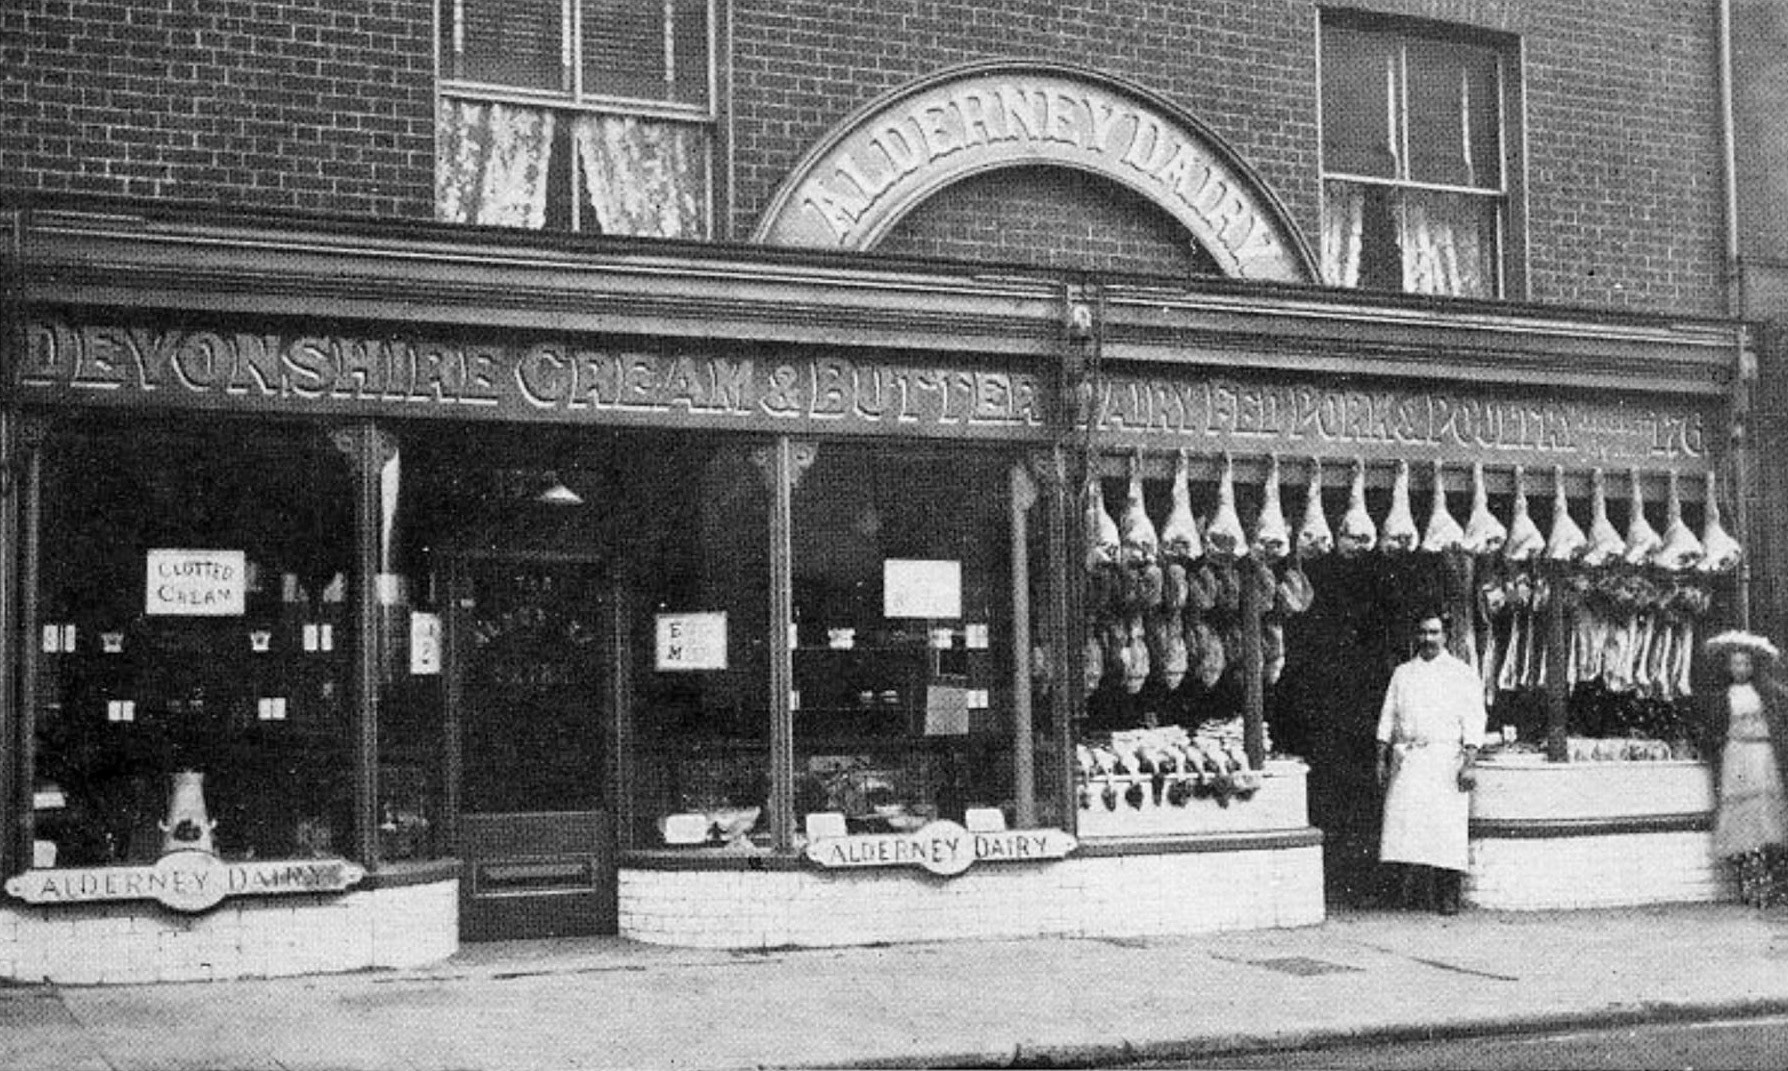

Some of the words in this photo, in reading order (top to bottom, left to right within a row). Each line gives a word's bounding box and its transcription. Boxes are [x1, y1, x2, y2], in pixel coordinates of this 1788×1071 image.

[801, 88, 1113, 247] ALDERNEY
[1119, 110, 1284, 279] DAIRY
[21, 321, 498, 405] DEVONSHIRE
[514, 343, 752, 415] CREAM
[759, 362, 800, 418] &
[807, 355, 1042, 426] BUTTER
[1287, 384, 1396, 443] PORK
[157, 562, 235, 582] CLOTTED
[157, 584, 233, 606] CREAM
[831, 836, 960, 864] ALDERNEY
[974, 833, 1047, 859] DAIRY
[40, 869, 210, 899] ALDERNEY
[227, 864, 324, 892] DAIRY
